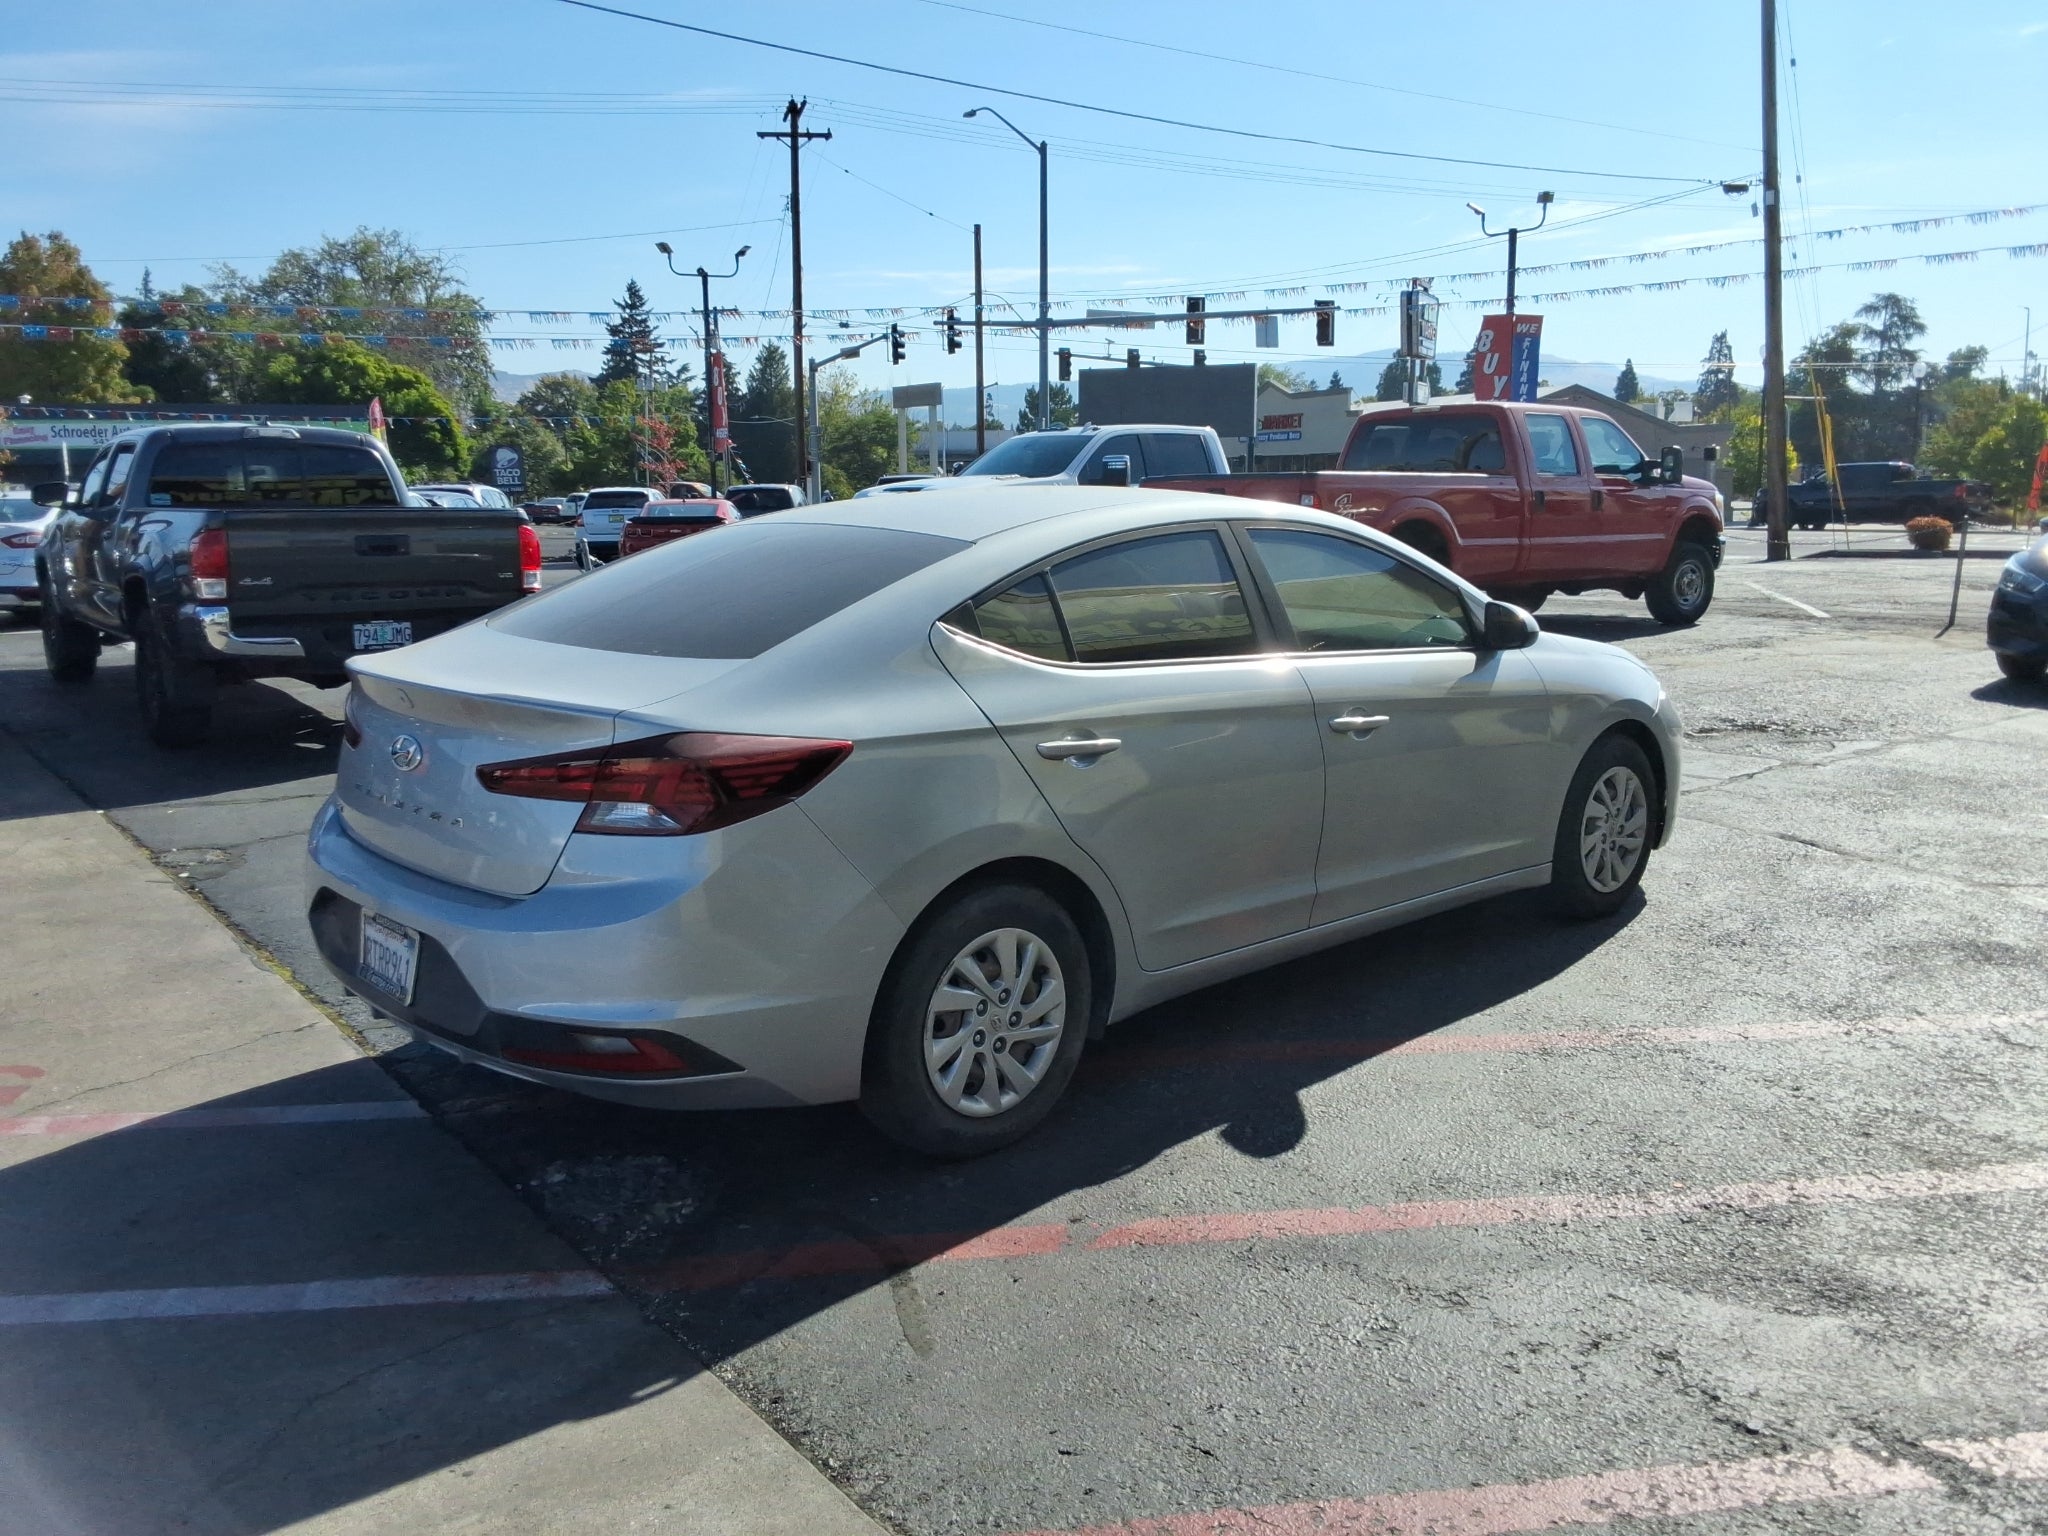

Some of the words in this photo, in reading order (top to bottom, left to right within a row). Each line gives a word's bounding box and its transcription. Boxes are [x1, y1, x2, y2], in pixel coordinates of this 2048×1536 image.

[1517, 323, 1539, 334] WE
[1478, 329, 1508, 398] BUY
[1519, 338, 1532, 403] FINANC
[50, 425, 109, 439] Schroeder
[493, 468, 521, 477] TACO
[496, 476, 522, 485] BELL
[354, 627, 379, 645] 794
[388, 626, 412, 643] JMG
